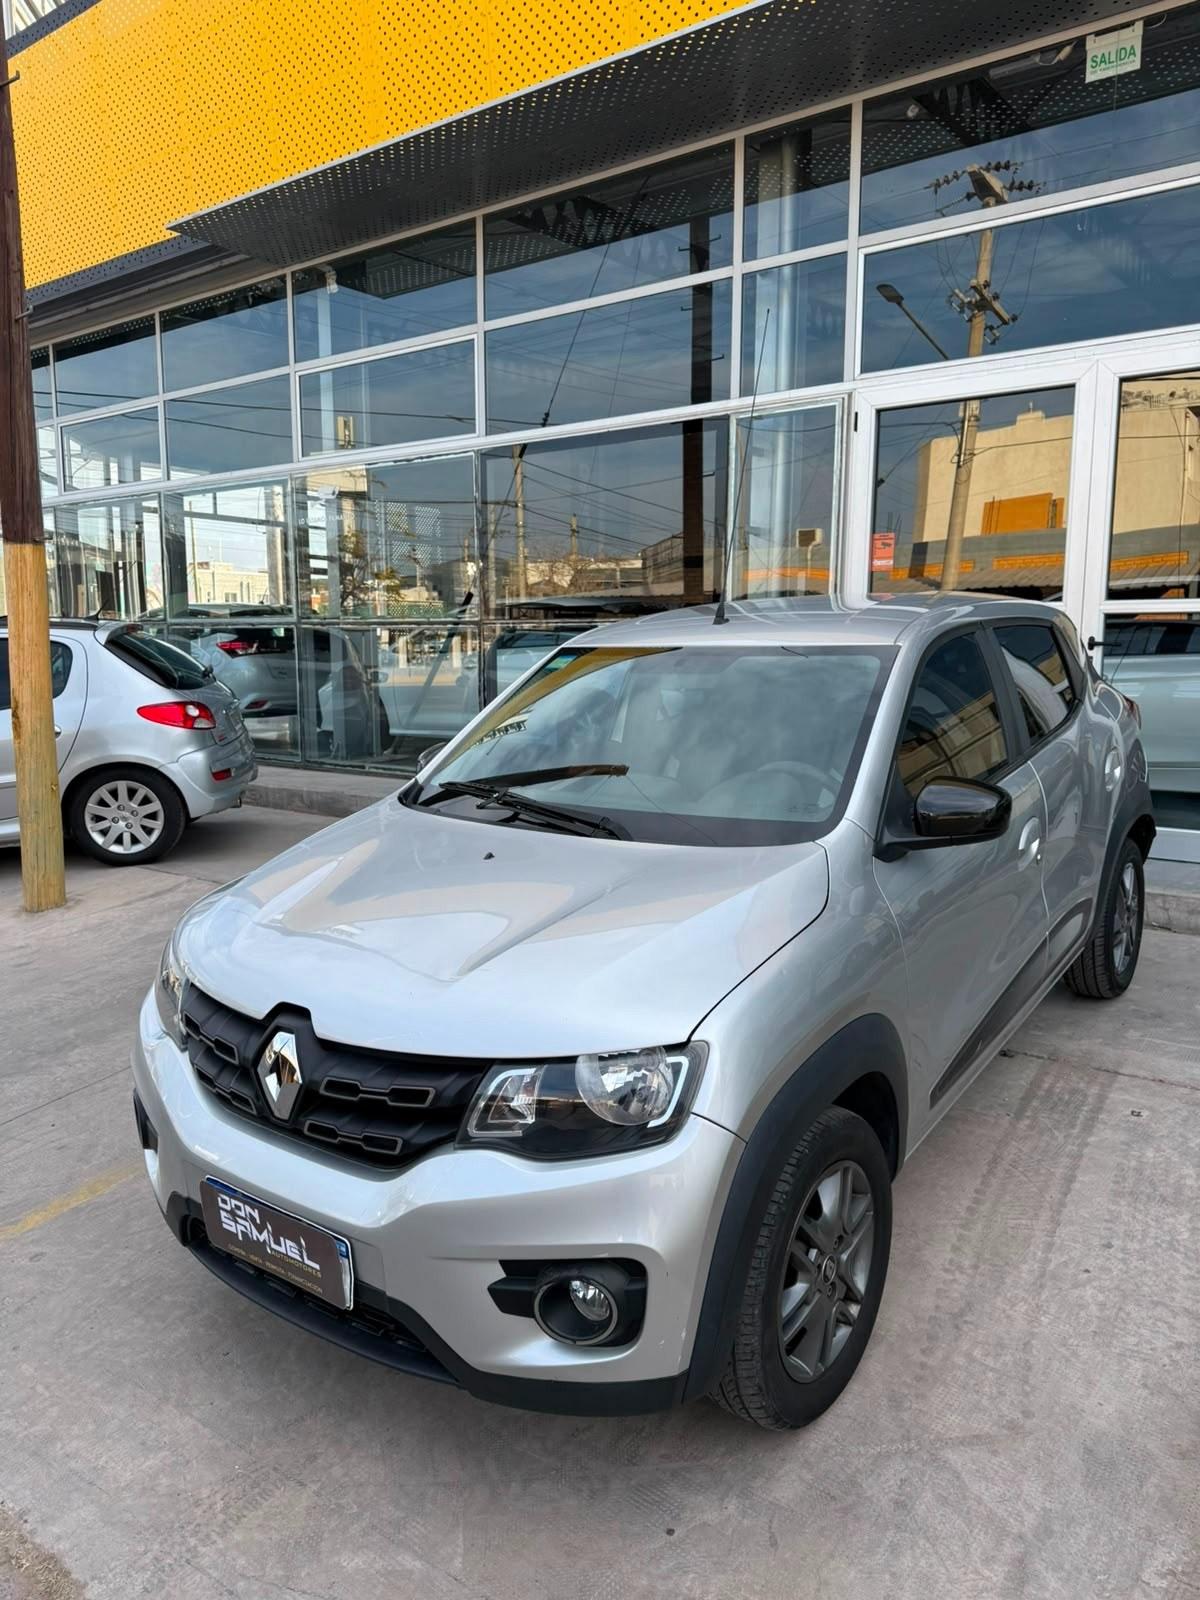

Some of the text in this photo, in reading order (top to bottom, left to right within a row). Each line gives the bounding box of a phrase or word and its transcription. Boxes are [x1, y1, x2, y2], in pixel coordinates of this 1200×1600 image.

[1090, 44, 1137, 69] SALIDA
[217, 1194, 261, 1225] DON
[220, 1210, 320, 1271] SAMUEL
